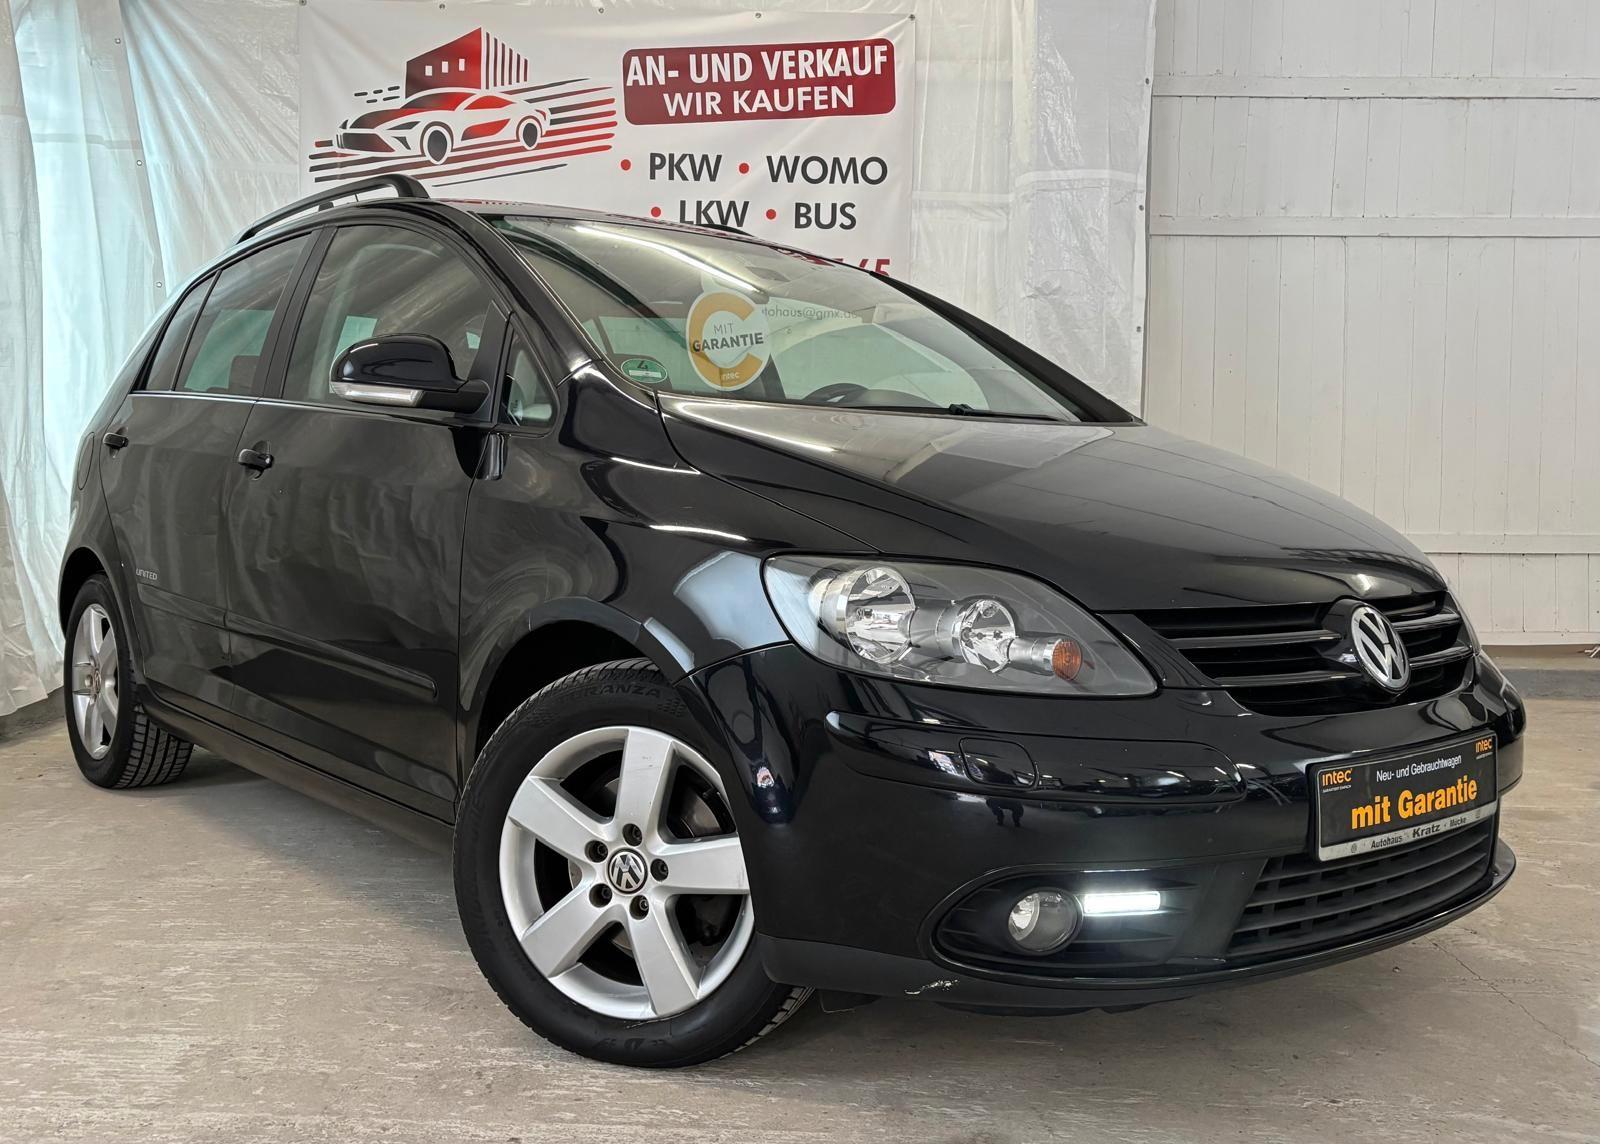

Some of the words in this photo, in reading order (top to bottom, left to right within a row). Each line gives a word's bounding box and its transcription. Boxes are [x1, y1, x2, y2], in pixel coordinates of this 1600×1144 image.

[626, 55, 679, 86] AN-
[689, 52, 752, 83] UND
[760, 45, 887, 81] VERKAUF
[663, 91, 722, 117] WIR
[733, 85, 854, 114] KAUFEN
[649, 152, 722, 182] PKW
[766, 155, 888, 185] WOMO
[679, 200, 749, 228] LKW
[794, 202, 857, 230] BUS
[692, 332, 764, 352] GARANTIE
[714, 322, 734, 335] MIT
[136, 567, 158, 581] UNITED
[1376, 770, 1395, 783] Neu-
[1396, 765, 1410, 779] und
[1411, 754, 1462, 776] Gebrauchtwagen
[1351, 796, 1391, 829] mit
[1398, 775, 1477, 819] Garantie
[1370, 834, 1403, 850] Autohaus
[1412, 824, 1441, 839] Kratz
